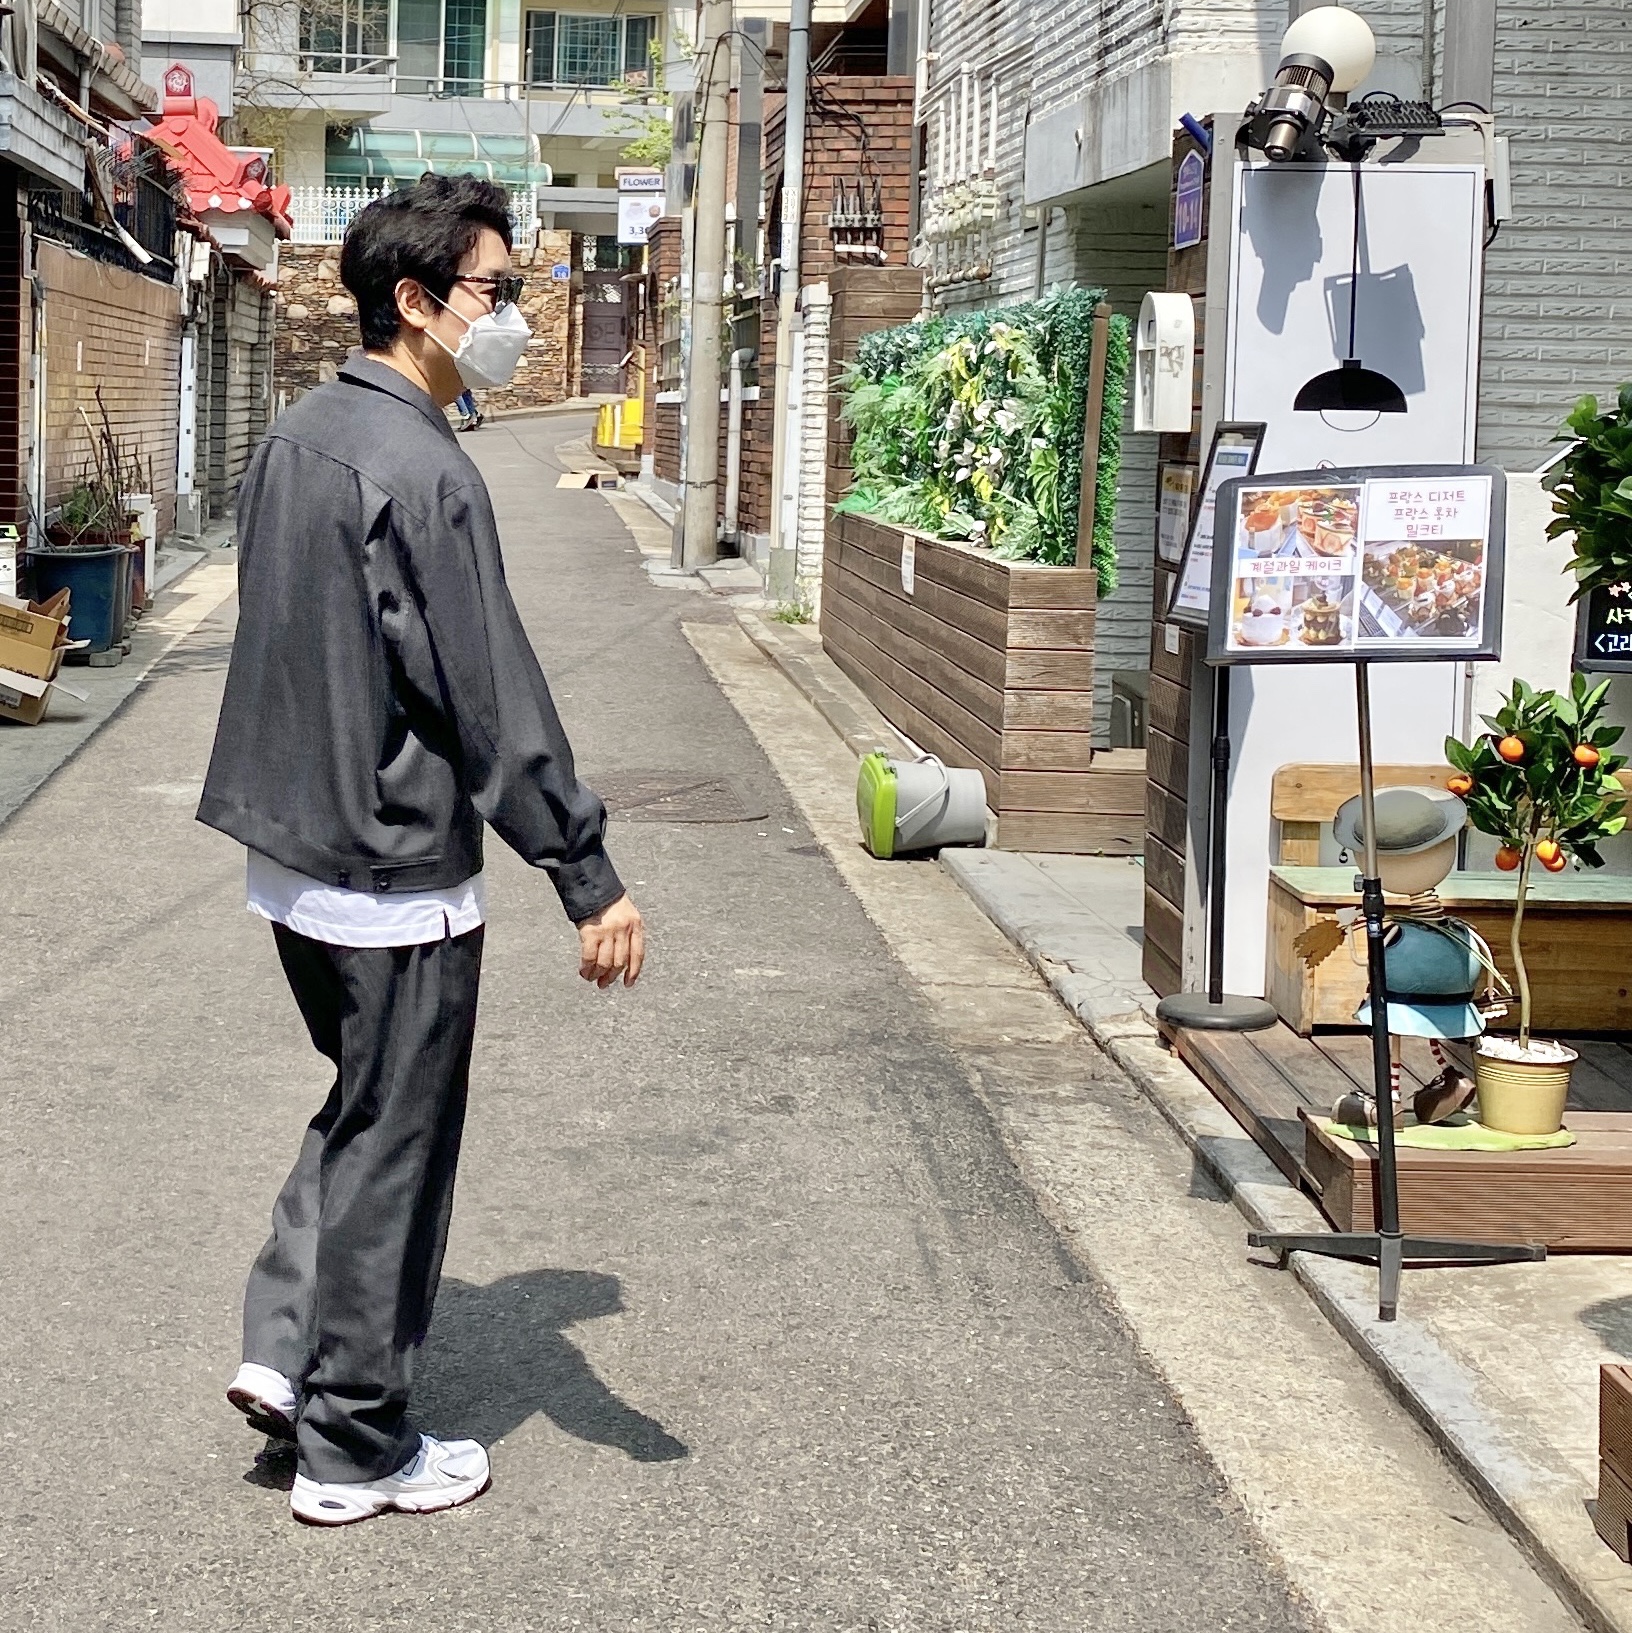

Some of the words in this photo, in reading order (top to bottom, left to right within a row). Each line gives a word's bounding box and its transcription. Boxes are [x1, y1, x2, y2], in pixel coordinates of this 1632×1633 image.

[623, 178, 660, 186] FLOWER
[1388, 491, 1423, 504] 프랑스
[1428, 490, 1466, 502] 디저트
[1394, 507, 1429, 520] 프랑스
[1434, 506, 1458, 520] 홍차
[1406, 524, 1443, 538] 밀크티
[1250, 560, 1300, 575] 계절과일
[1305, 560, 1342, 572] 케이크
